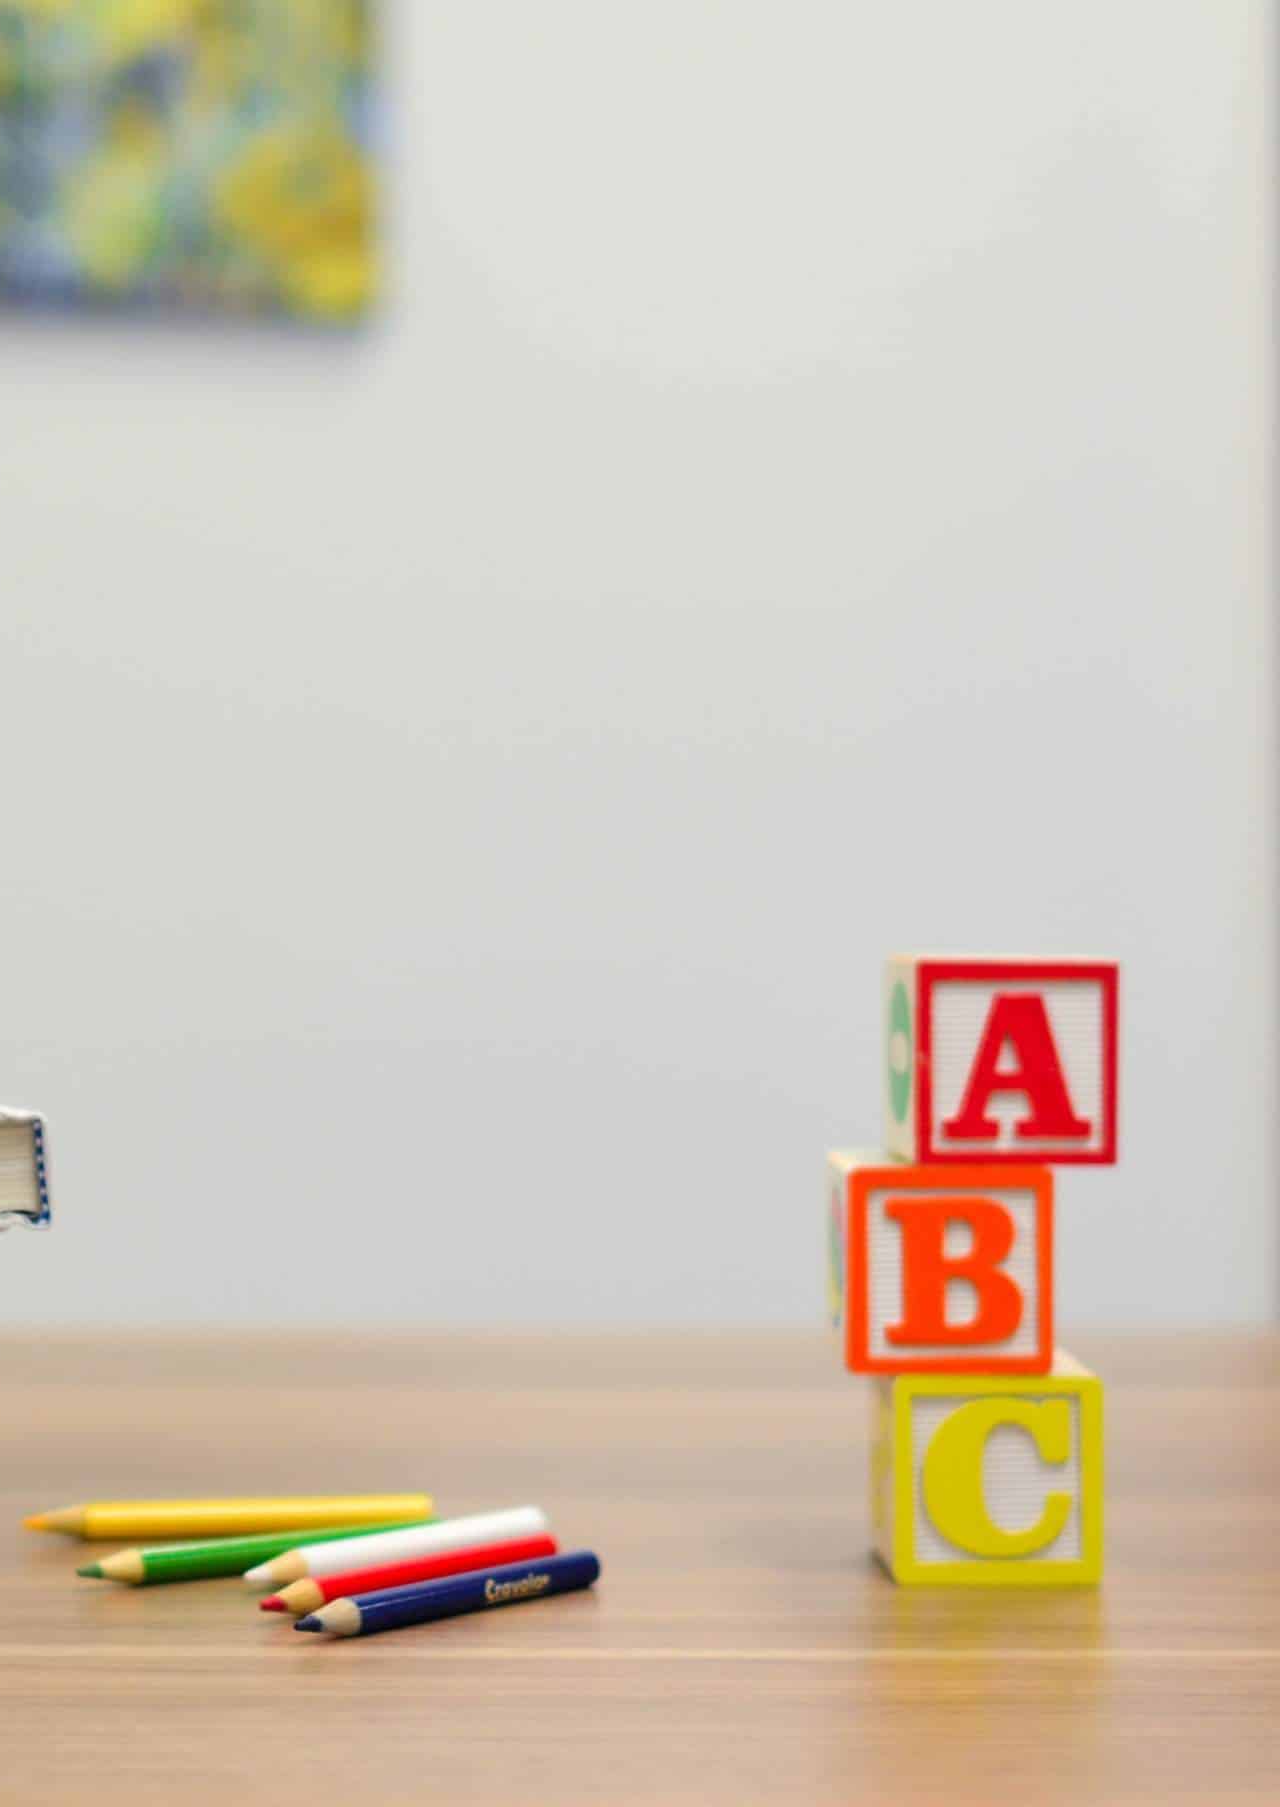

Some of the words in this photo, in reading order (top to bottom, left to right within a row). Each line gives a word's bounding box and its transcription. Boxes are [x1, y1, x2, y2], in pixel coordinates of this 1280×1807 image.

[941, 992, 1092, 1142] A
[884, 1196, 1024, 1346] B
[922, 1395, 1072, 1558] C
